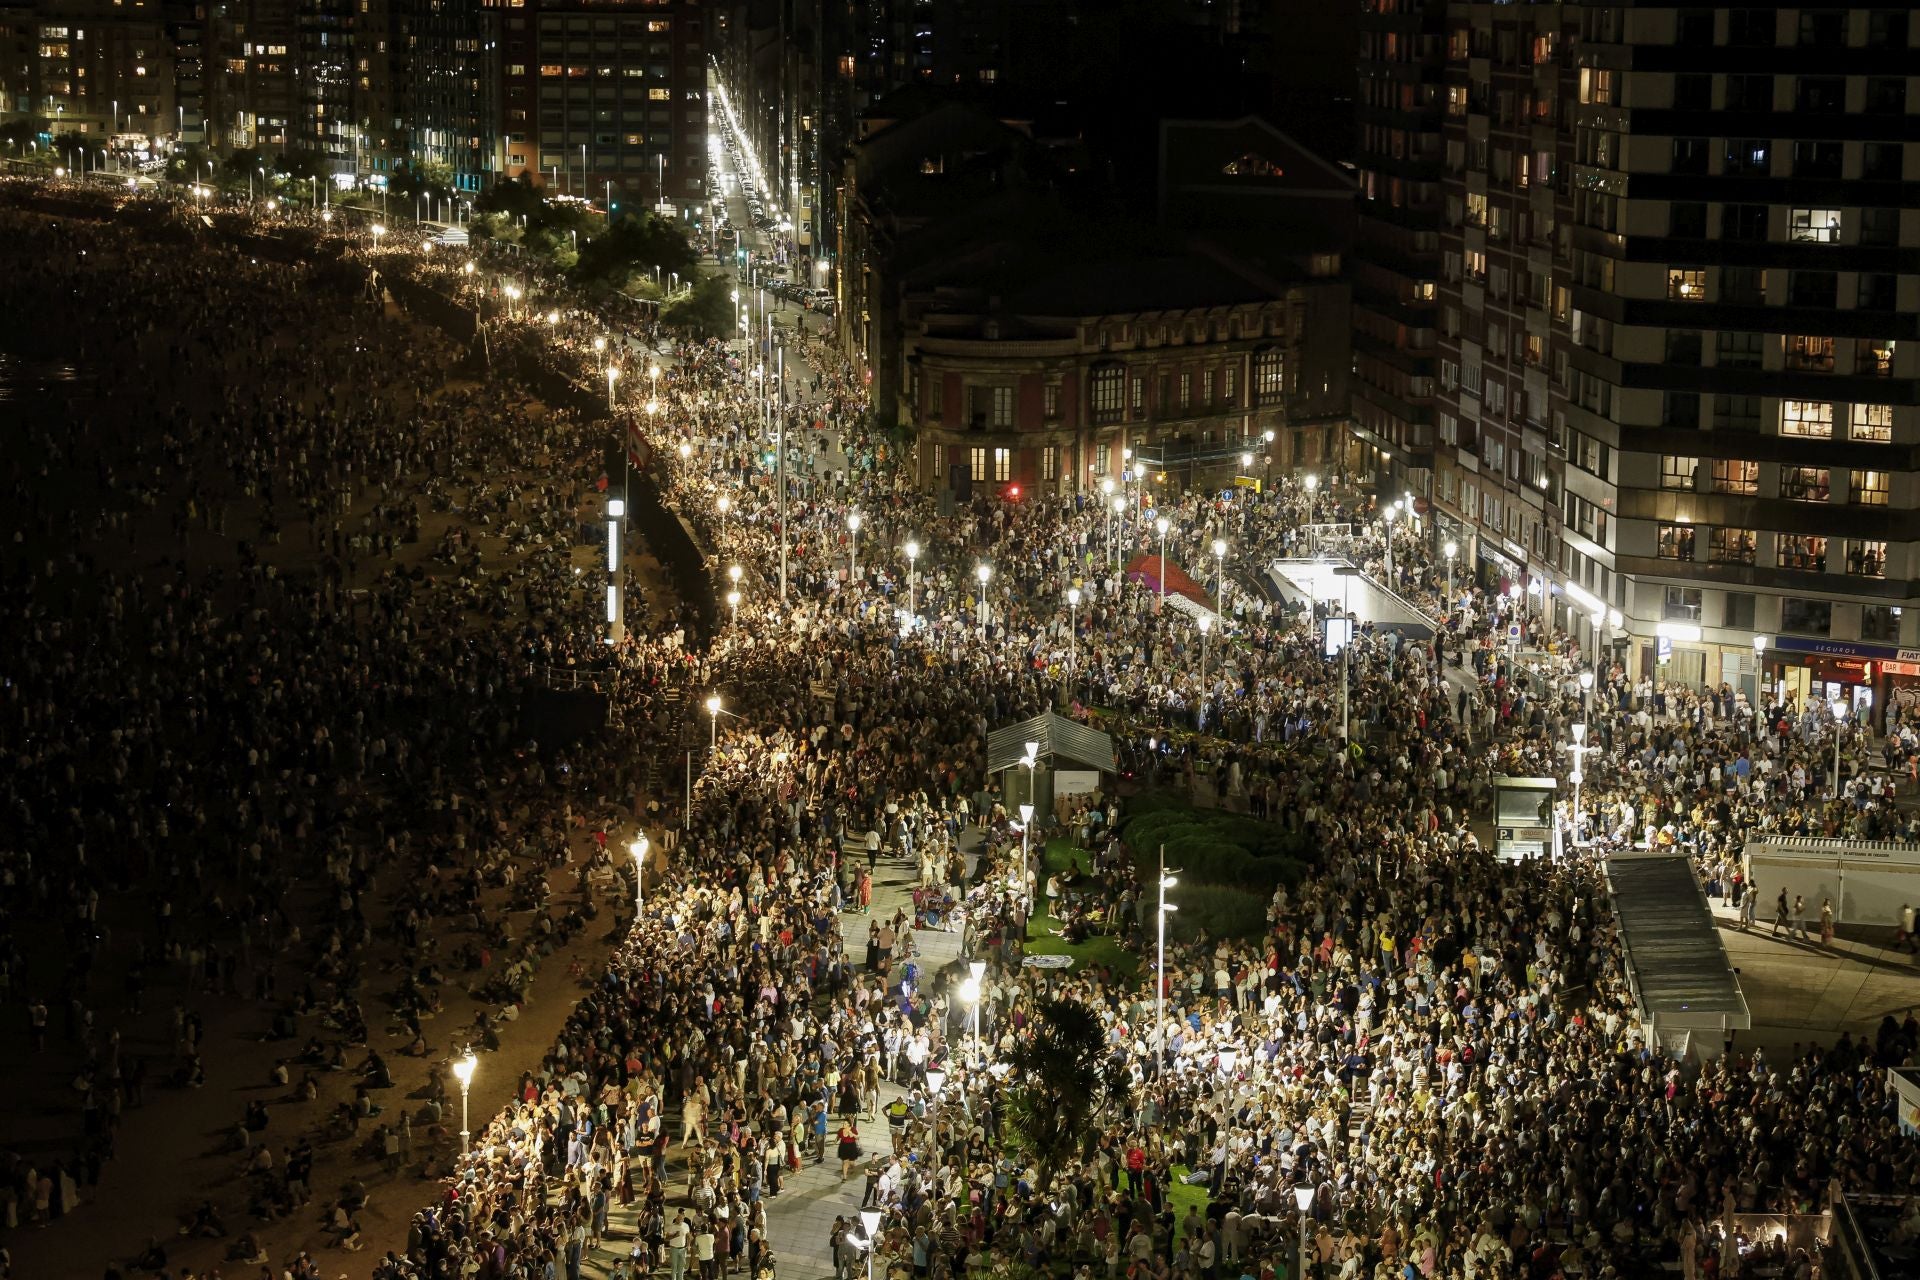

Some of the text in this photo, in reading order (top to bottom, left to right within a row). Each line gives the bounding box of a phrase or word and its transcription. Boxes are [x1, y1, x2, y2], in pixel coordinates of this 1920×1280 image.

[1815, 645, 1856, 654] SEGUROS
[1901, 651, 1920, 660] FIAT
[1885, 662, 1897, 671] BAR
[1500, 829, 1508, 840] P
